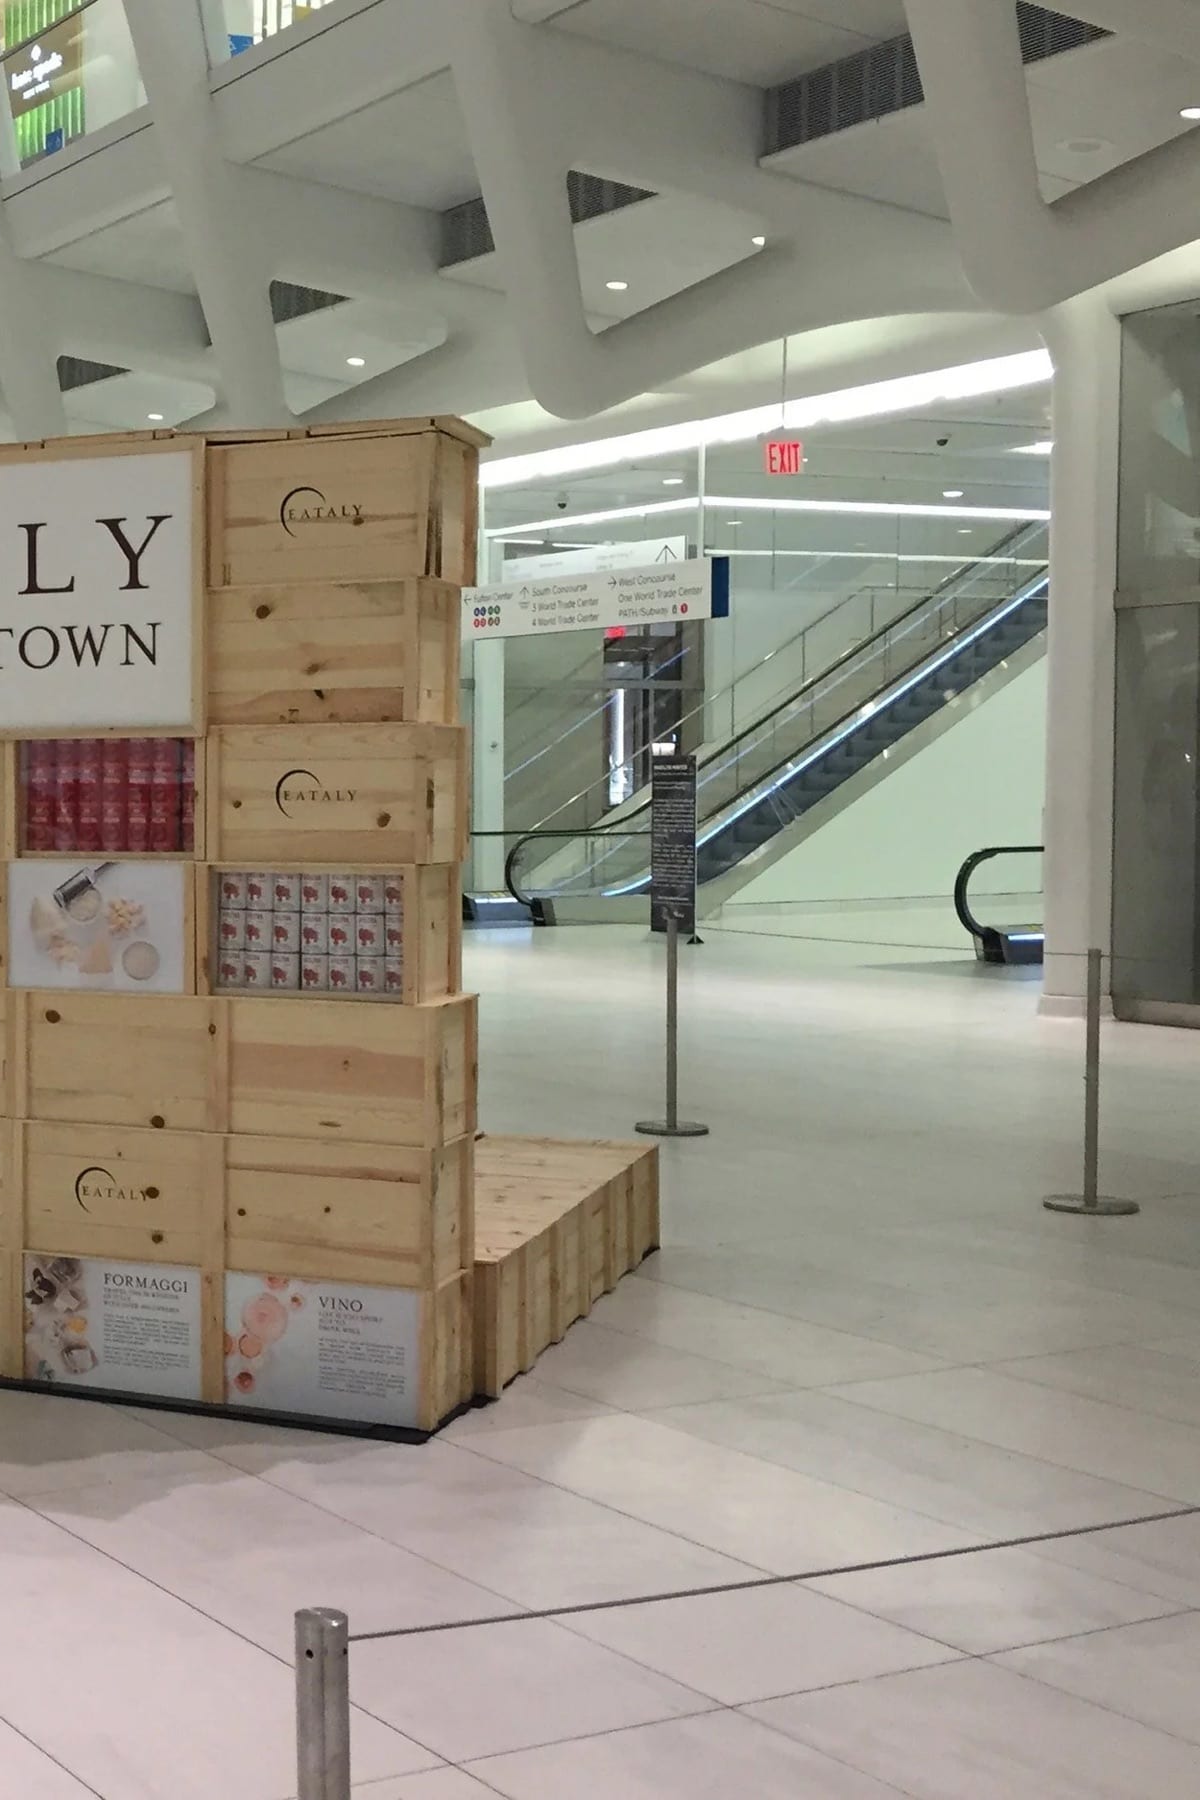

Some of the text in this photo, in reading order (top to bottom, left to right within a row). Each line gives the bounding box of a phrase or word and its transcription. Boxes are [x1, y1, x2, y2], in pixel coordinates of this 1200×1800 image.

[768, 442, 800, 473] EXIT
[288, 504, 362, 520] EATALY
[617, 586, 703, 604] One World Trade Center
[283, 789, 357, 802] EATALY
[103, 1272, 188, 1294] FORMAGGI
[318, 1295, 363, 1313] VINO
